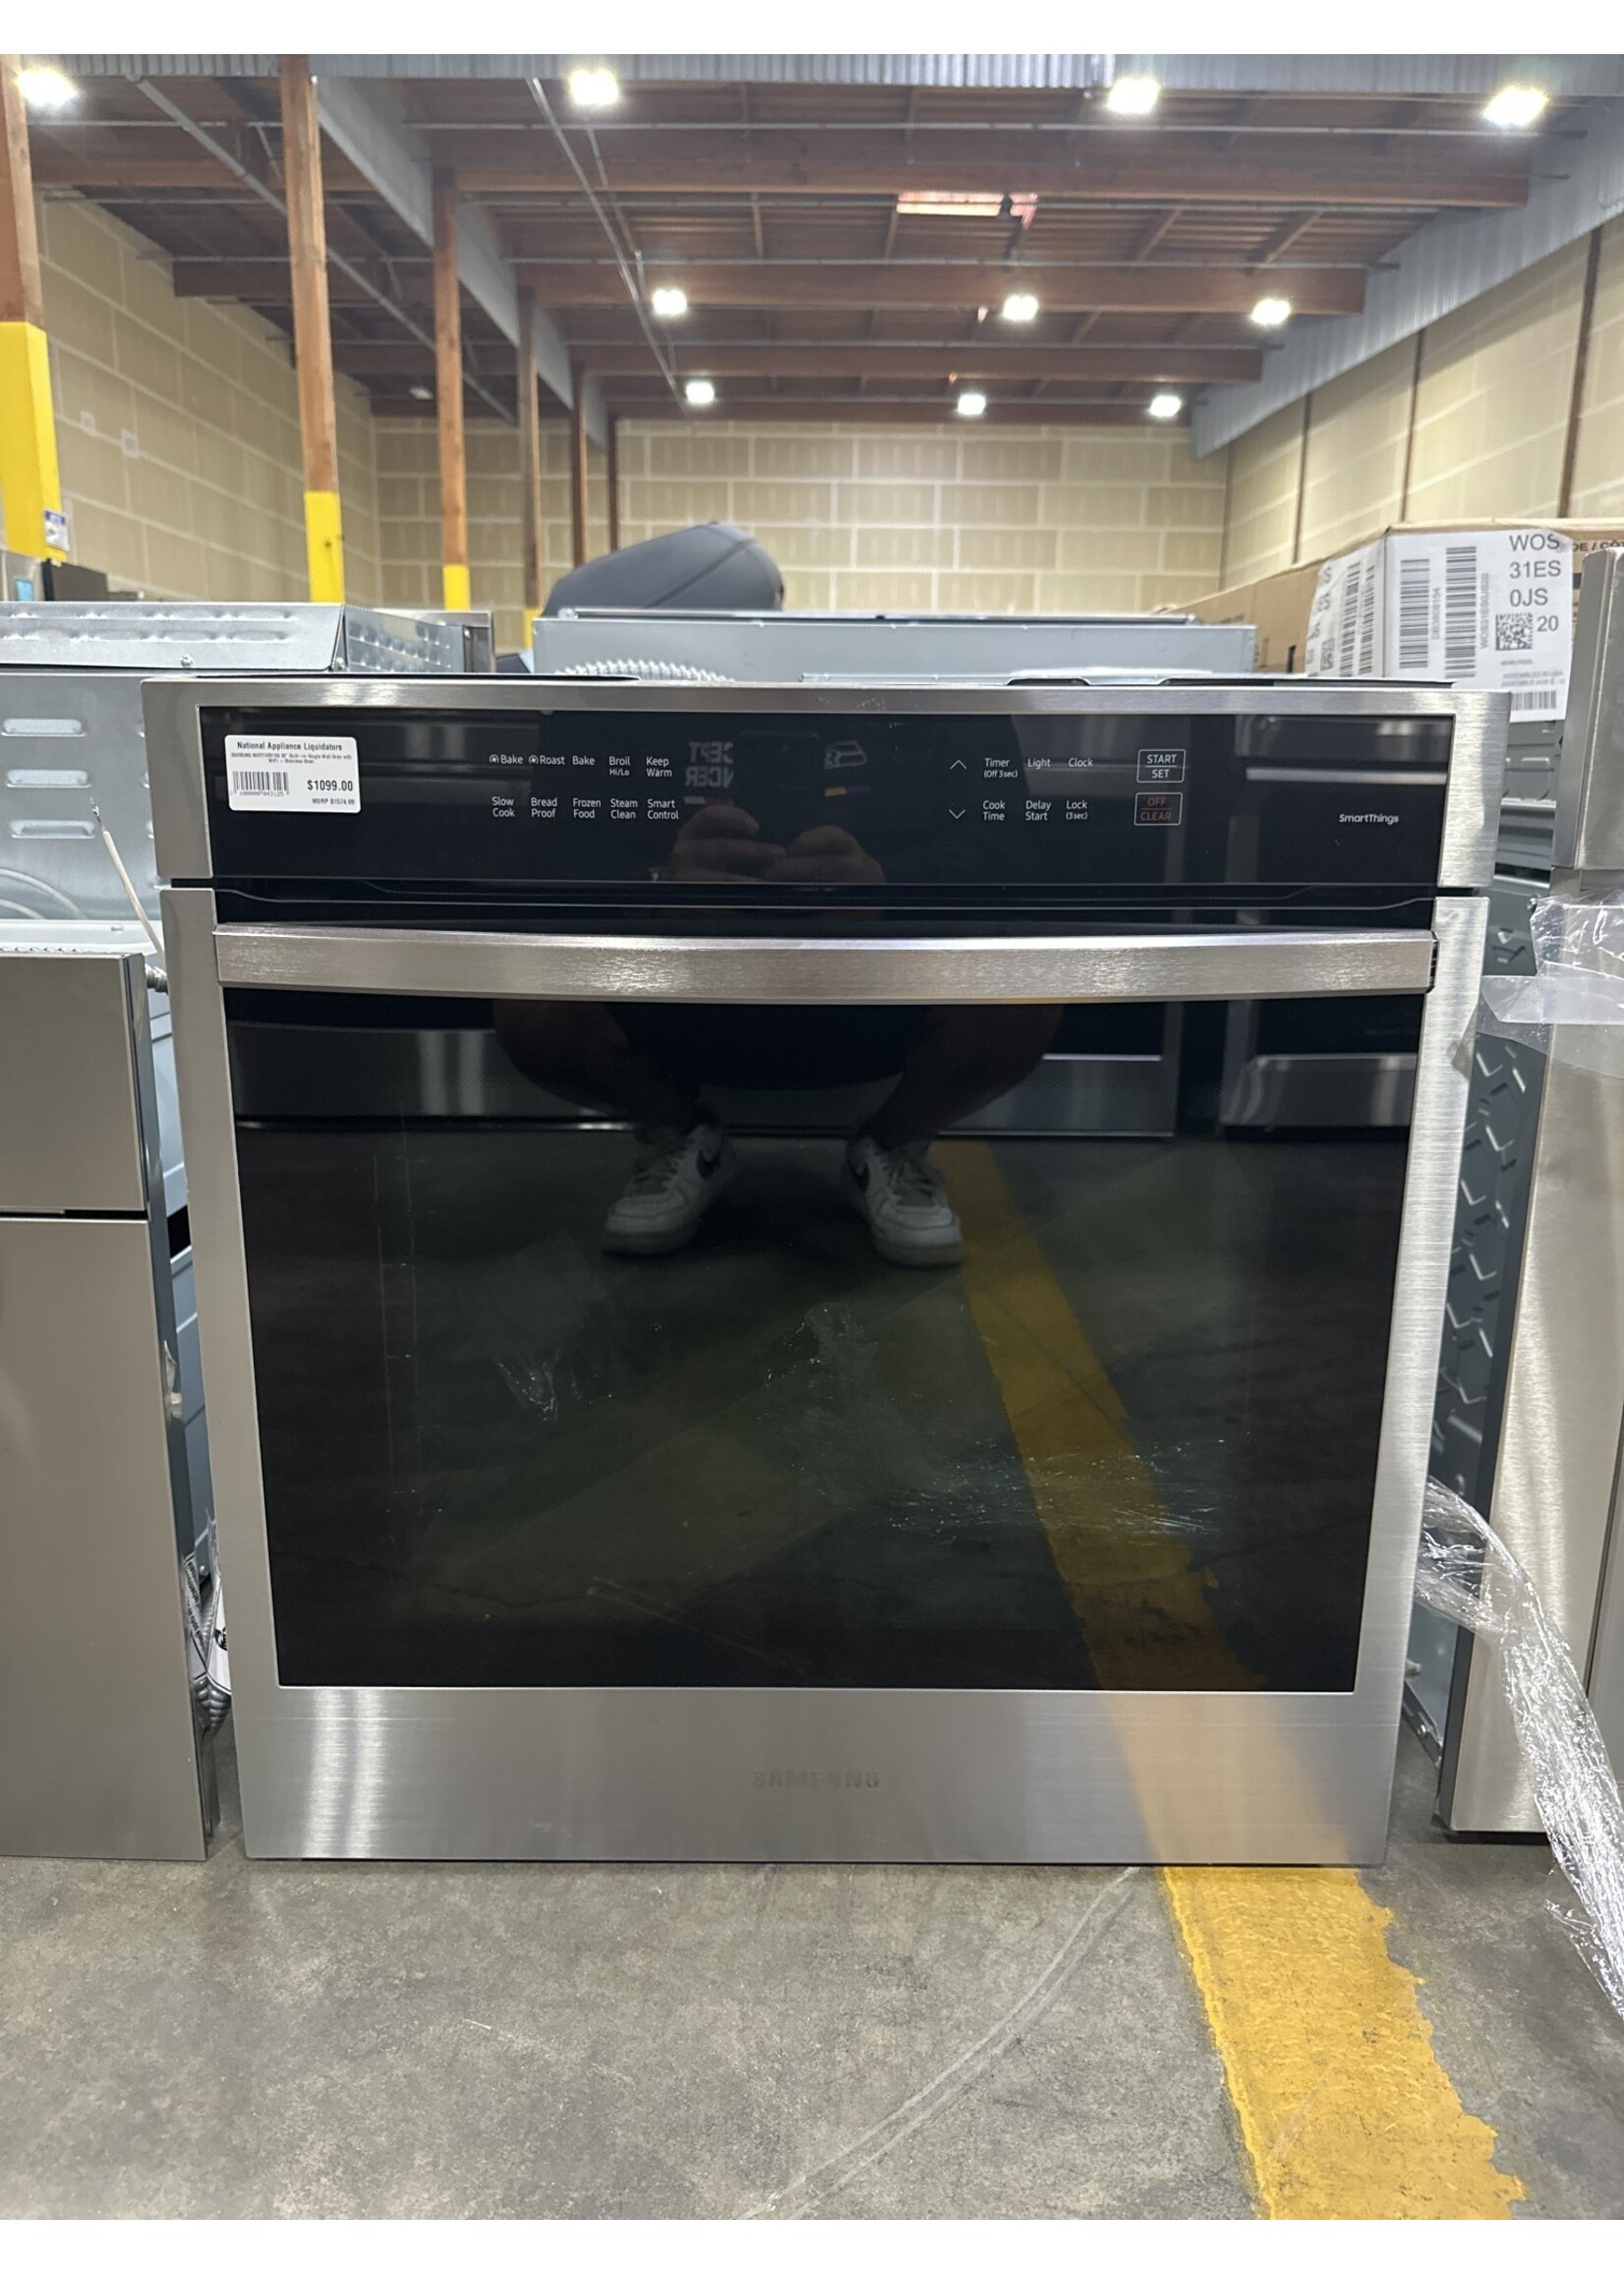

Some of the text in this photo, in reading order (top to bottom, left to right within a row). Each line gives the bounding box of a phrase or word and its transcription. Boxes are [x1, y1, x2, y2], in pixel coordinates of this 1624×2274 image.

[1509, 533, 1560, 552] WOS
[1509, 559, 1561, 579] 31ES
[1537, 614, 1559, 632] 20
[237, 741, 342, 752] National Appliance Liquidators
[500, 754, 524, 765] Bake
[539, 755, 566, 765] Roast
[572, 755, 596, 766] Bake
[609, 756, 631, 766] Broil
[646, 756, 669, 769] Keep
[984, 757, 1010, 768] Timer
[1027, 757, 1051, 770] Light
[1068, 757, 1093, 768] Clock
[1146, 754, 1177, 765] START
[609, 768, 630, 777] Hi/Lo
[646, 768, 672, 778] Warm
[983, 769, 998, 779] (Off
[1151, 769, 1170, 779] SET
[307, 779, 354, 791] $1099.00
[492, 796, 514, 806] Slow
[531, 796, 558, 807] Bread
[572, 797, 602, 808] Frozen
[609, 798, 638, 808] Steam
[647, 798, 675, 809] Smart
[982, 799, 1006, 810] Cook
[1025, 800, 1052, 813] Delay
[1066, 800, 1088, 810] Lock
[1147, 796, 1167, 807] OFF
[492, 807, 515, 818] Cook
[531, 807, 556, 818] Proof
[573, 808, 596, 819] Food
[610, 809, 636, 820] Clean
[647, 809, 679, 820] Control
[982, 811, 1006, 822] Time
[1025, 811, 1048, 821] Start
[1140, 811, 1172, 822] CLEAR
[1339, 813, 1400, 825] SmartThings
[752, 1770, 881, 1788] SAMSUNG
